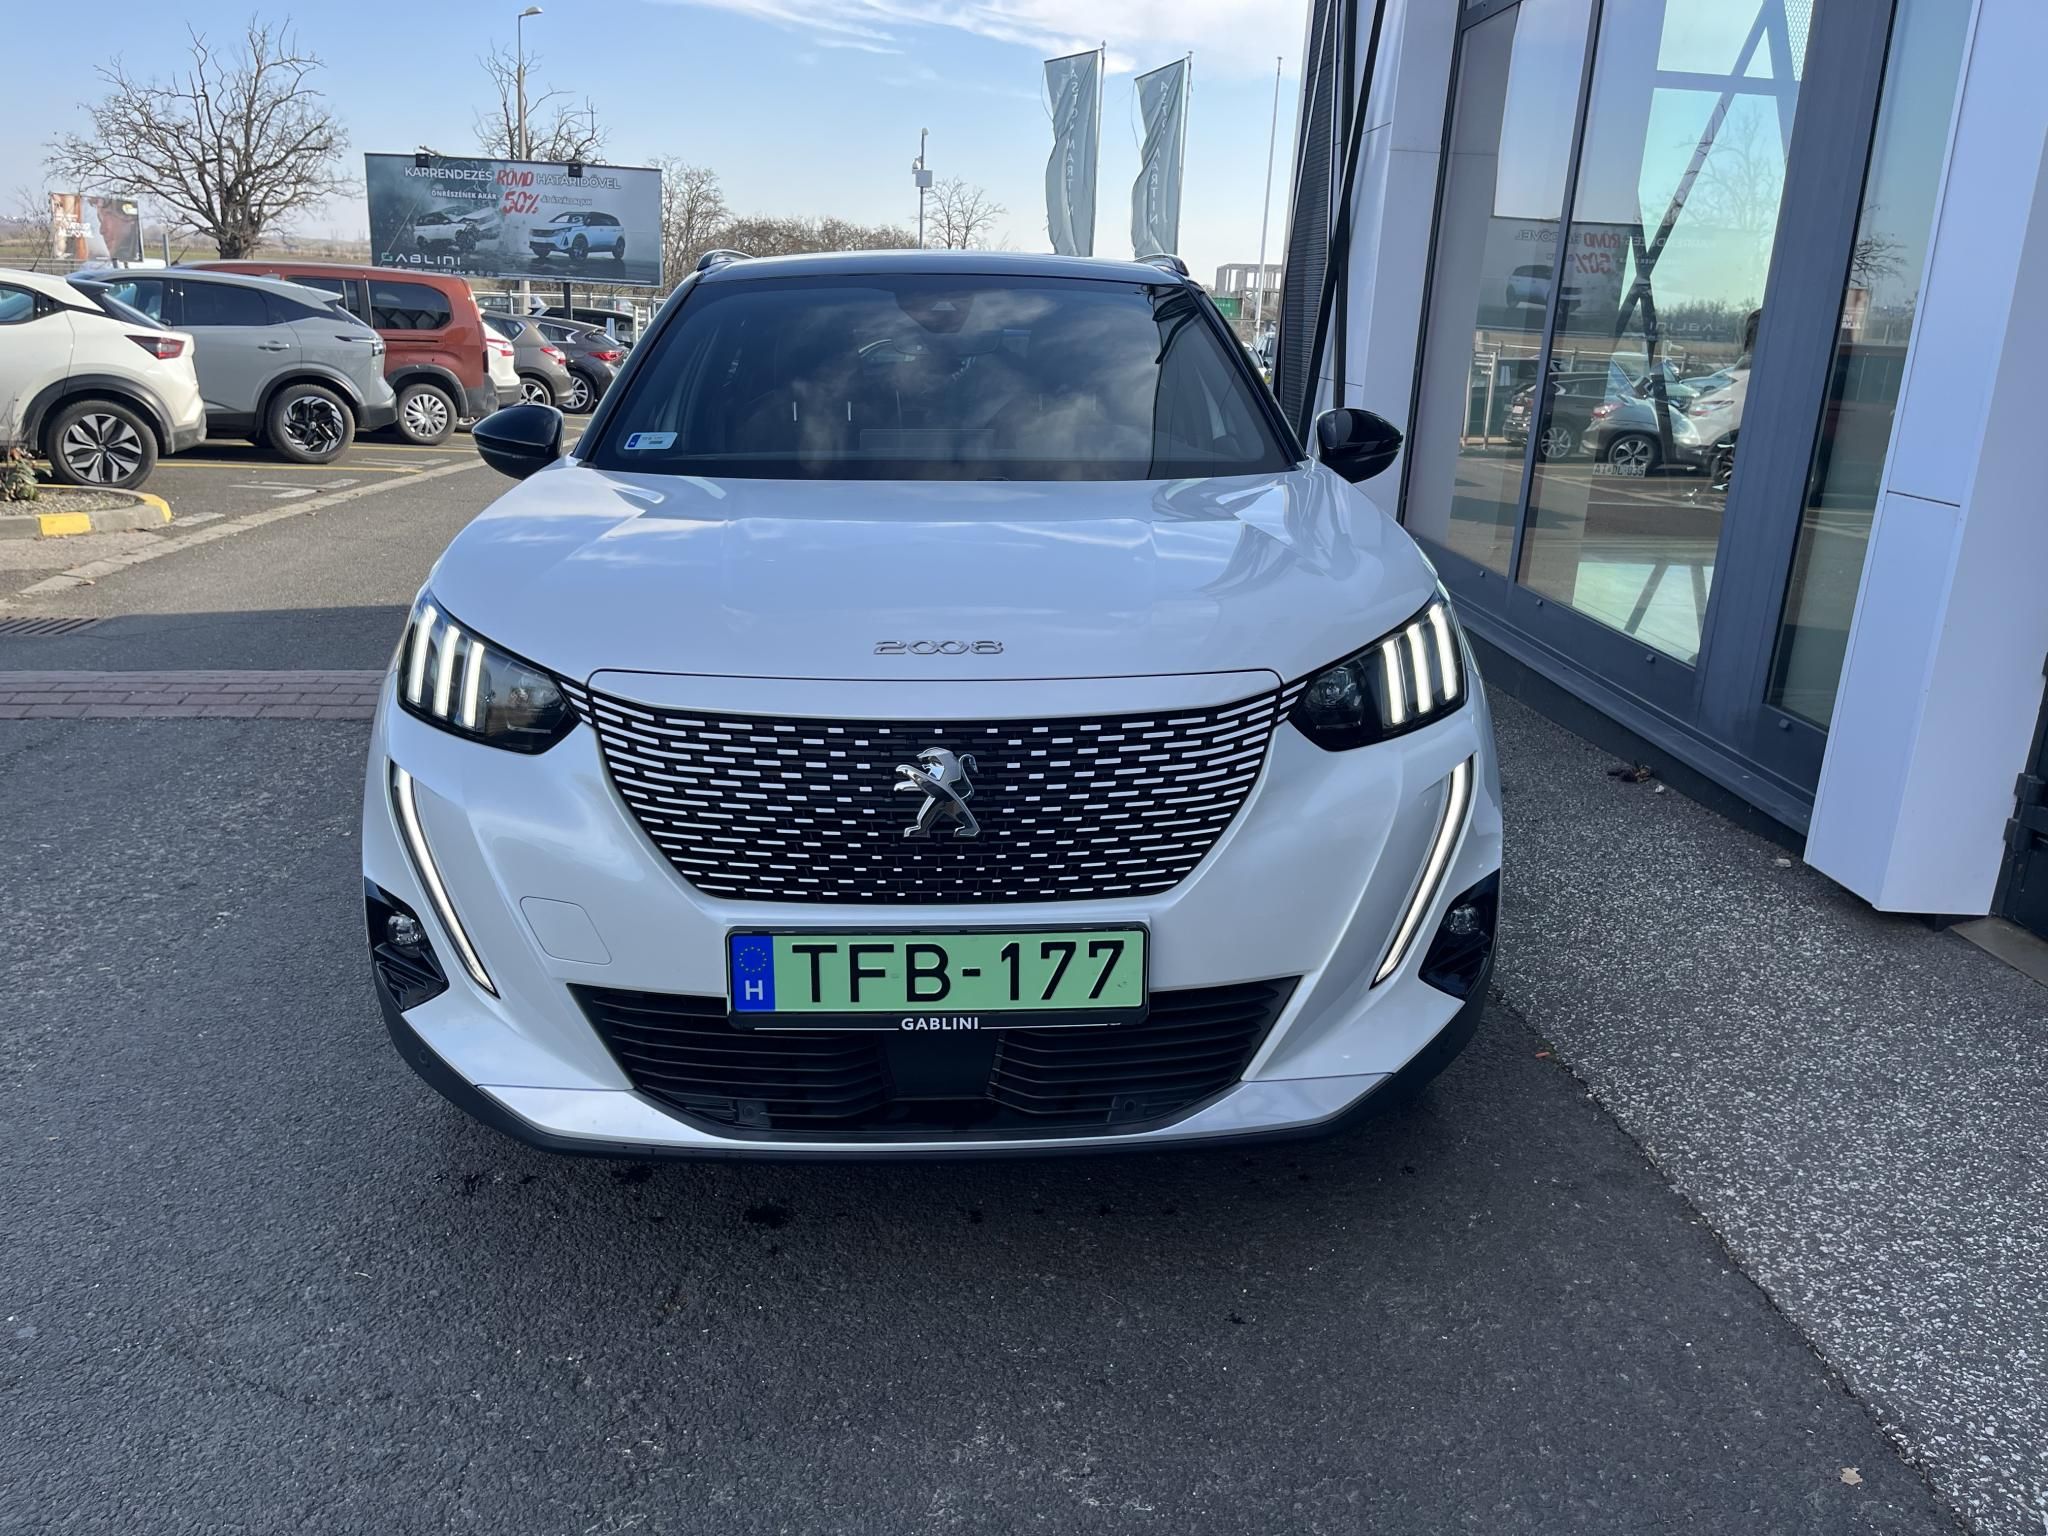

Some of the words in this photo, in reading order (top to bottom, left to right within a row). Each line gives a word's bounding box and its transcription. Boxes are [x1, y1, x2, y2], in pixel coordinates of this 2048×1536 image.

[502, 190, 540, 214] 50%
[381, 252, 461, 266] GABLINI
[873, 640, 1004, 655] 2008
[791, 939, 1126, 1004] TFB-177
[744, 979, 764, 1001] H
[901, 1016, 980, 1032] GABLINI
